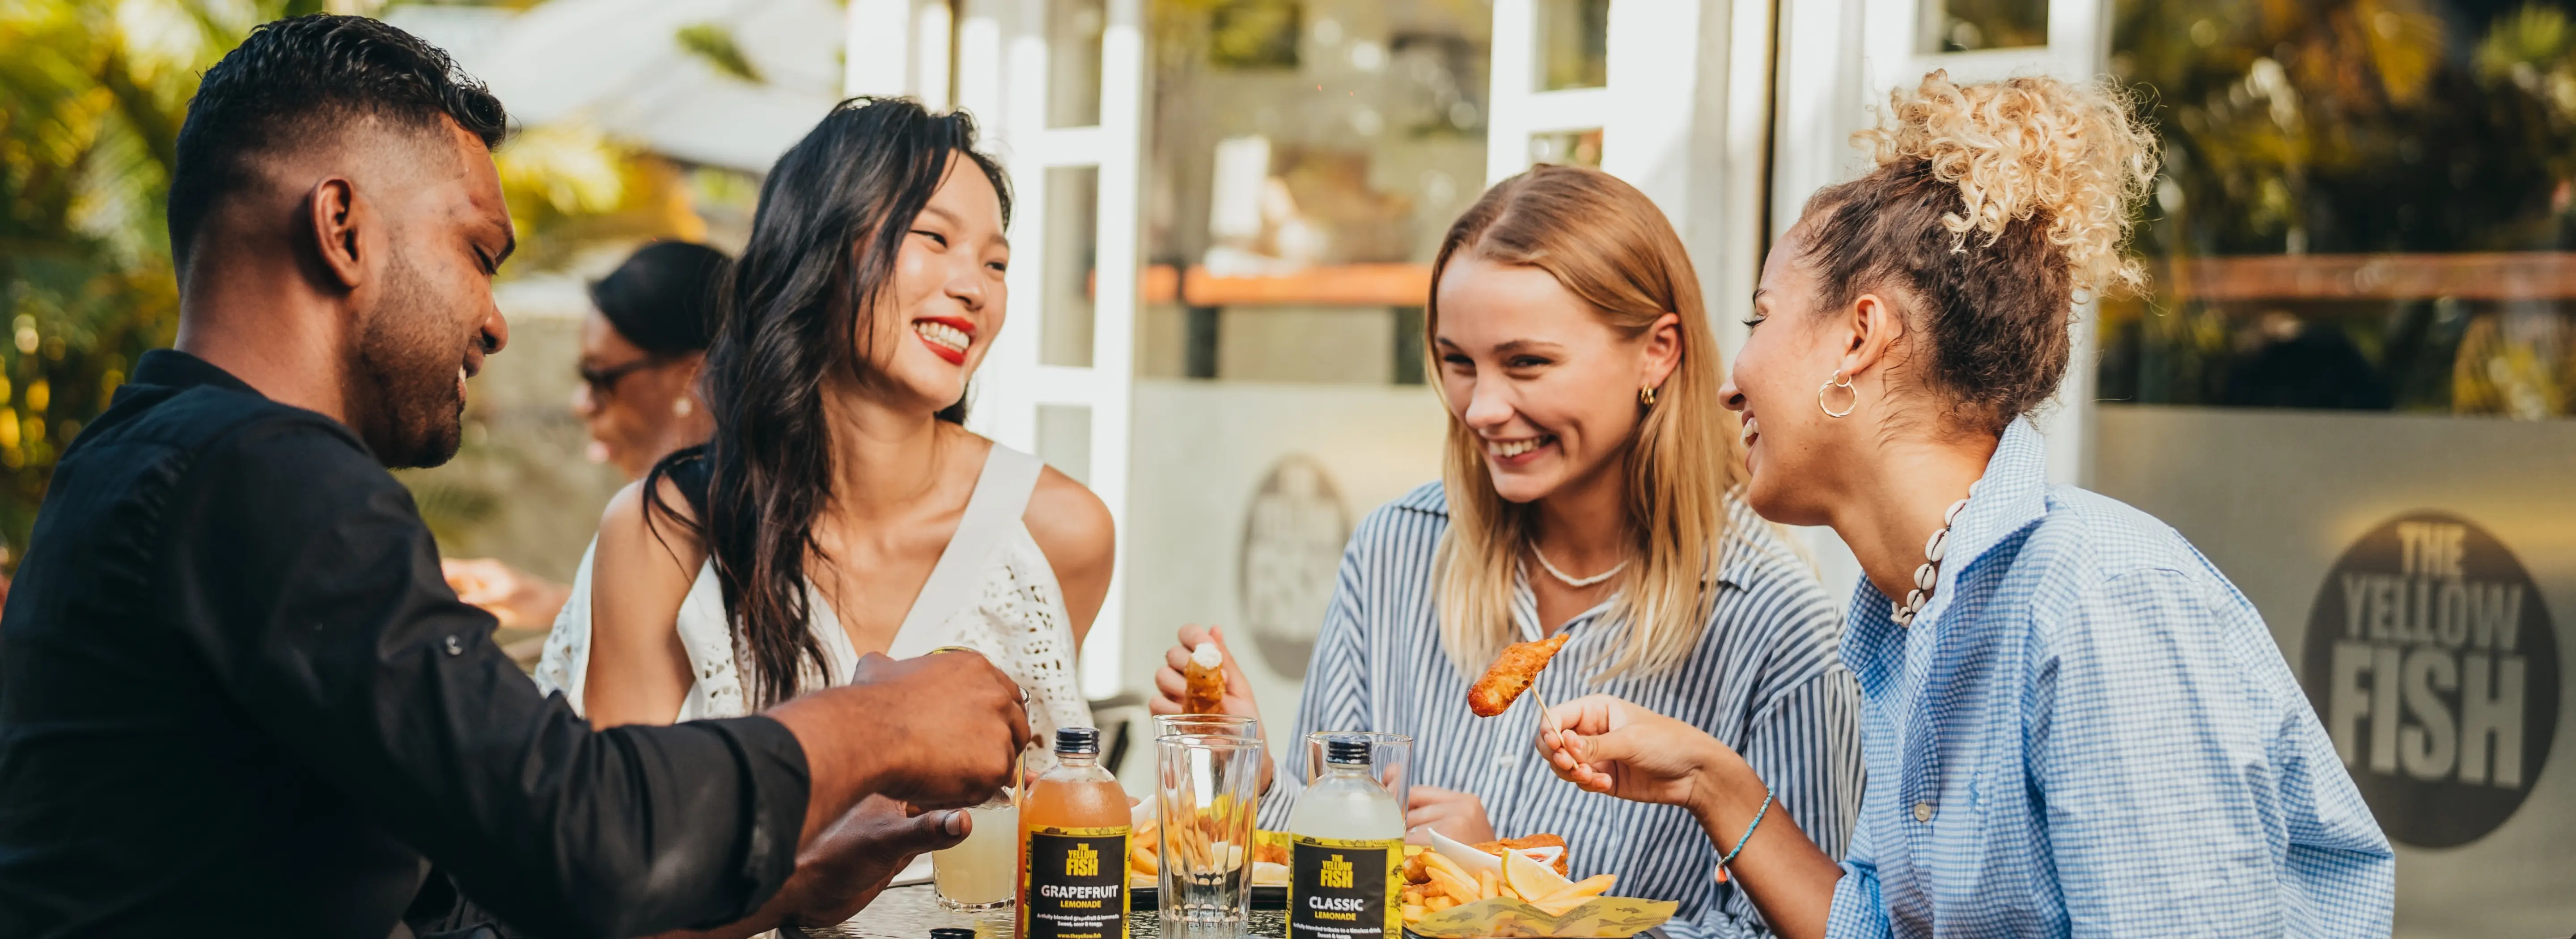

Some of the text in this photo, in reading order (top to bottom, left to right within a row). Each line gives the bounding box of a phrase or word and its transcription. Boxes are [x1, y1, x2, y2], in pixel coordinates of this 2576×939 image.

[2396, 521, 2465, 576] THE
[2339, 571, 2523, 651] YELLOW
[2330, 640, 2527, 788] FISH
[1068, 850, 1098, 859] YELLOW
[1331, 854, 1343, 862] THE
[1066, 858, 1099, 876] FISH
[1322, 860, 1353, 871] YELLOW
[1320, 869, 1353, 889] FISH
[1041, 884, 1119, 899] GRAPEFRUIT
[1060, 900, 1102, 908] LEMONADE
[1309, 896, 1364, 911] CLASSIC
[1315, 911, 1356, 921] LEMONADE
